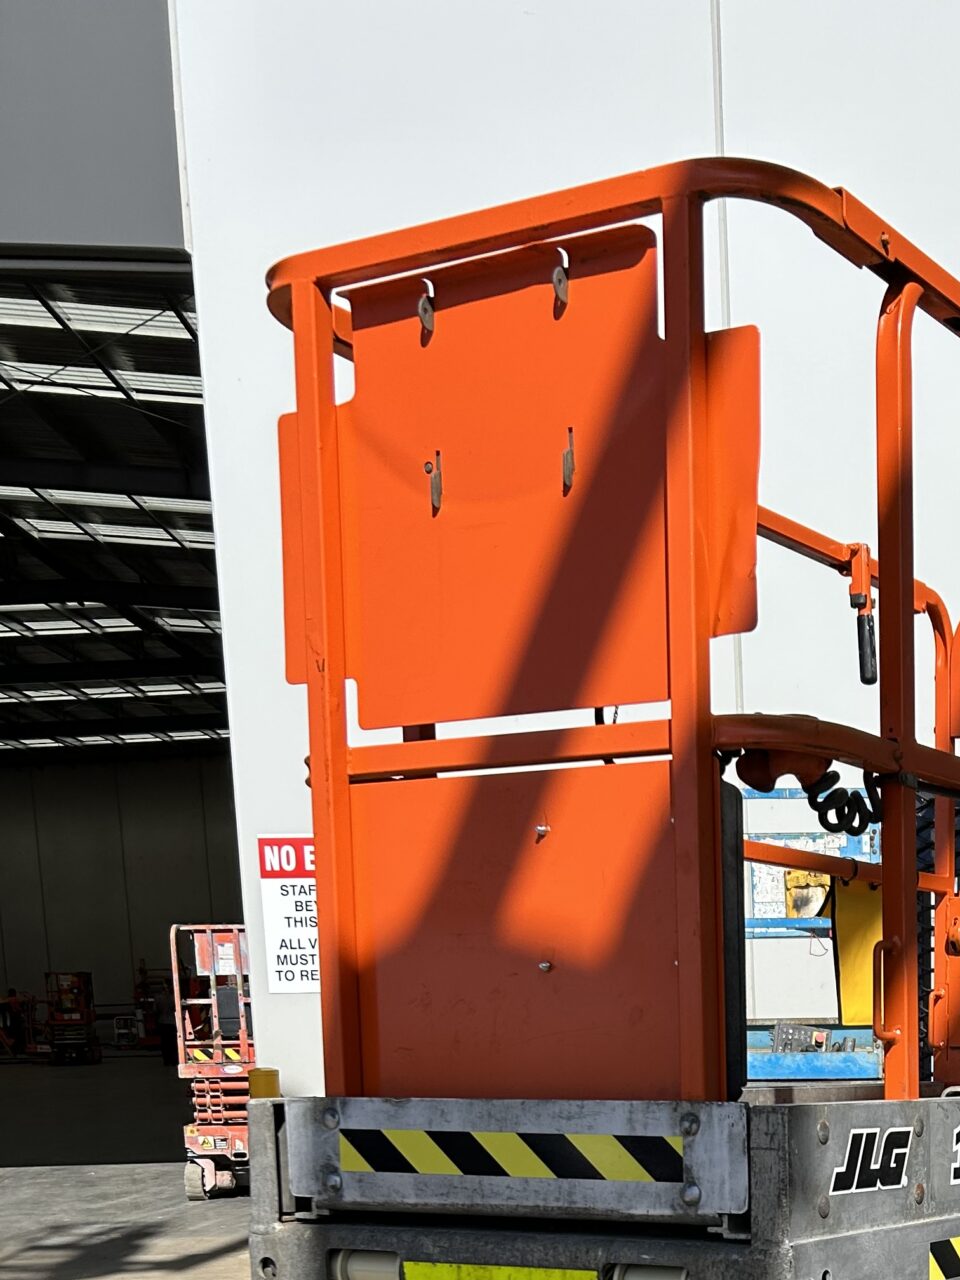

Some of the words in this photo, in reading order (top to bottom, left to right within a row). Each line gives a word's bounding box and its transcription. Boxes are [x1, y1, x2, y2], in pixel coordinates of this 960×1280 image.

[264, 844, 297, 871] NO
[284, 916, 318, 928] THIS
[279, 938, 306, 950] ALL
[276, 954, 317, 966] MUST
[275, 970, 295, 982] TO
[830, 1127, 912, 1194] JLG
